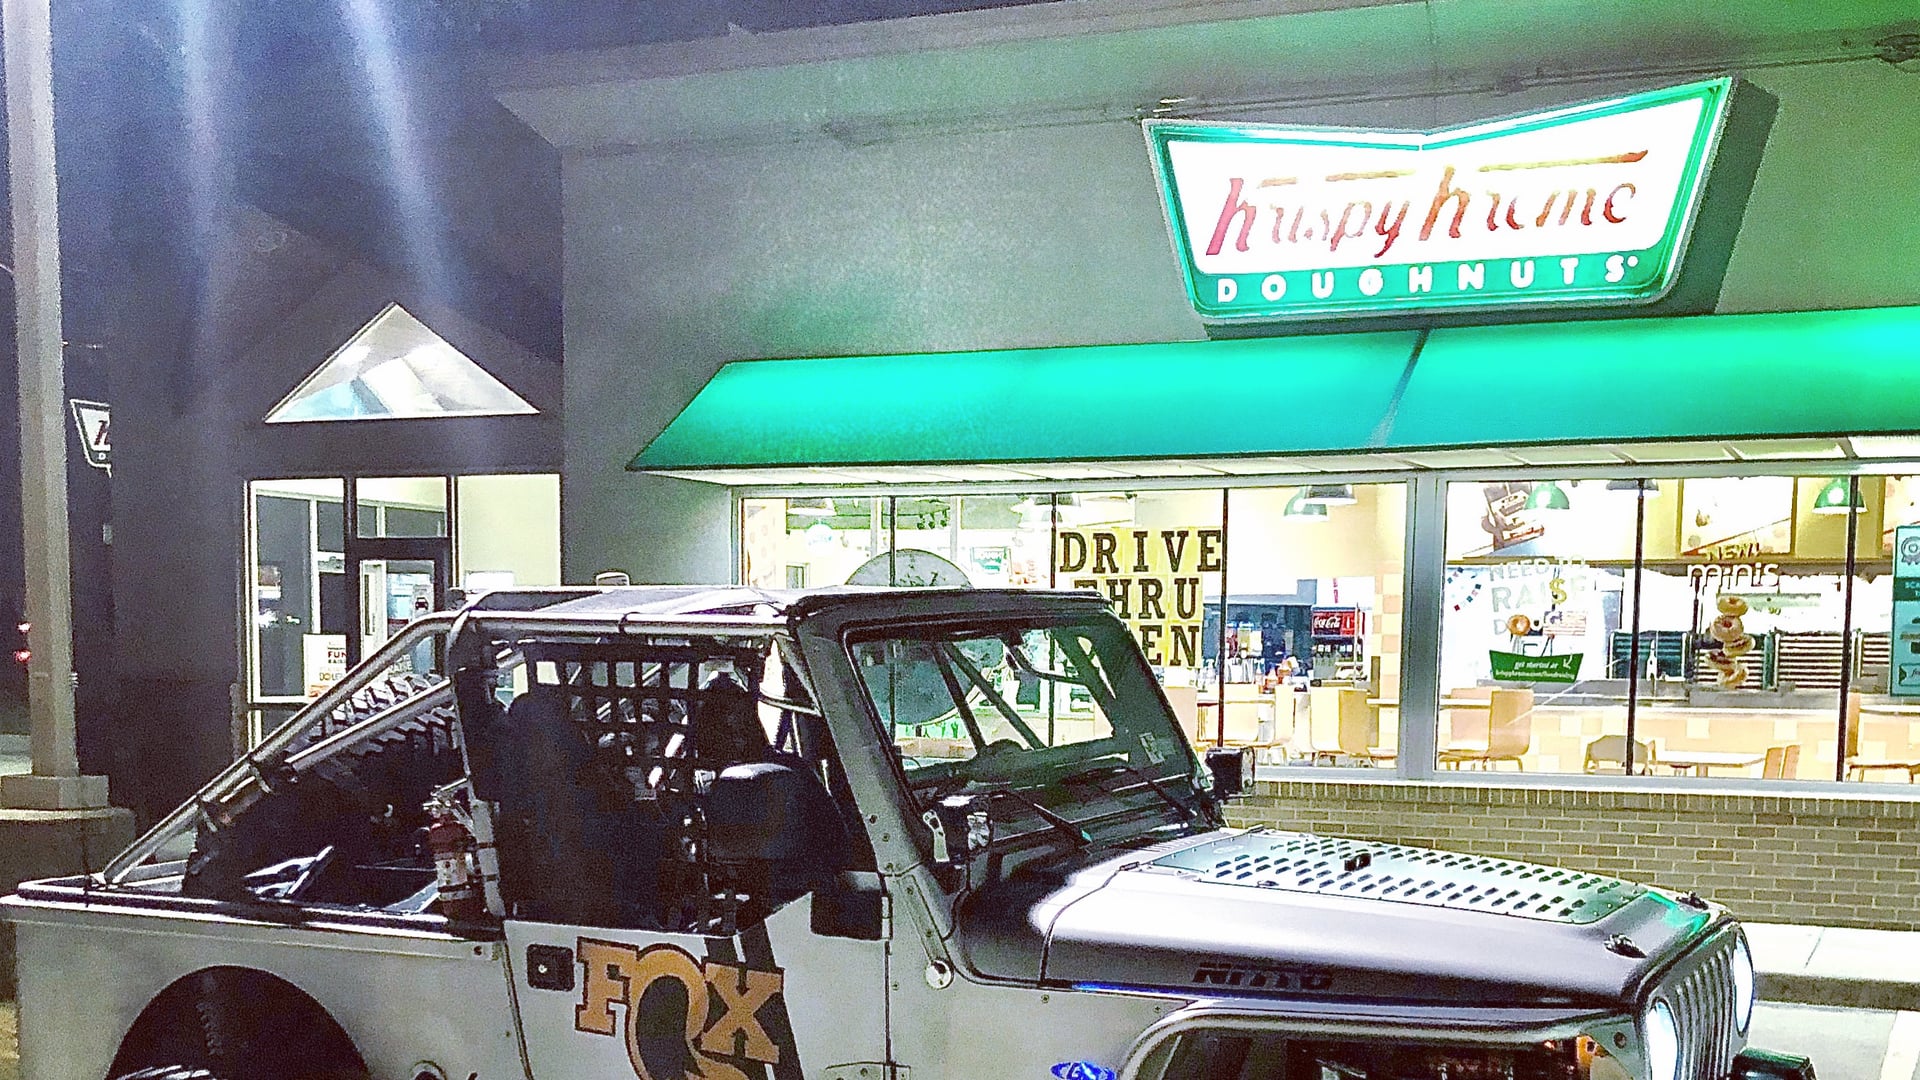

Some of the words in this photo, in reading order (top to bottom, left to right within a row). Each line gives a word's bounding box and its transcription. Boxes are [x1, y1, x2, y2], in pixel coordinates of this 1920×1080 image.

[1217, 255, 1627, 303] DOUGHNUTS
[1059, 529, 1222, 574] DRIVE
[1489, 558, 1550, 582] NEED
[1706, 542, 1760, 561] NEW!
[1686, 562, 1780, 587] minis
[1074, 577, 1200, 620] HRU
[1139, 625, 1200, 667] EN
[575, 936, 784, 1079] FOX
